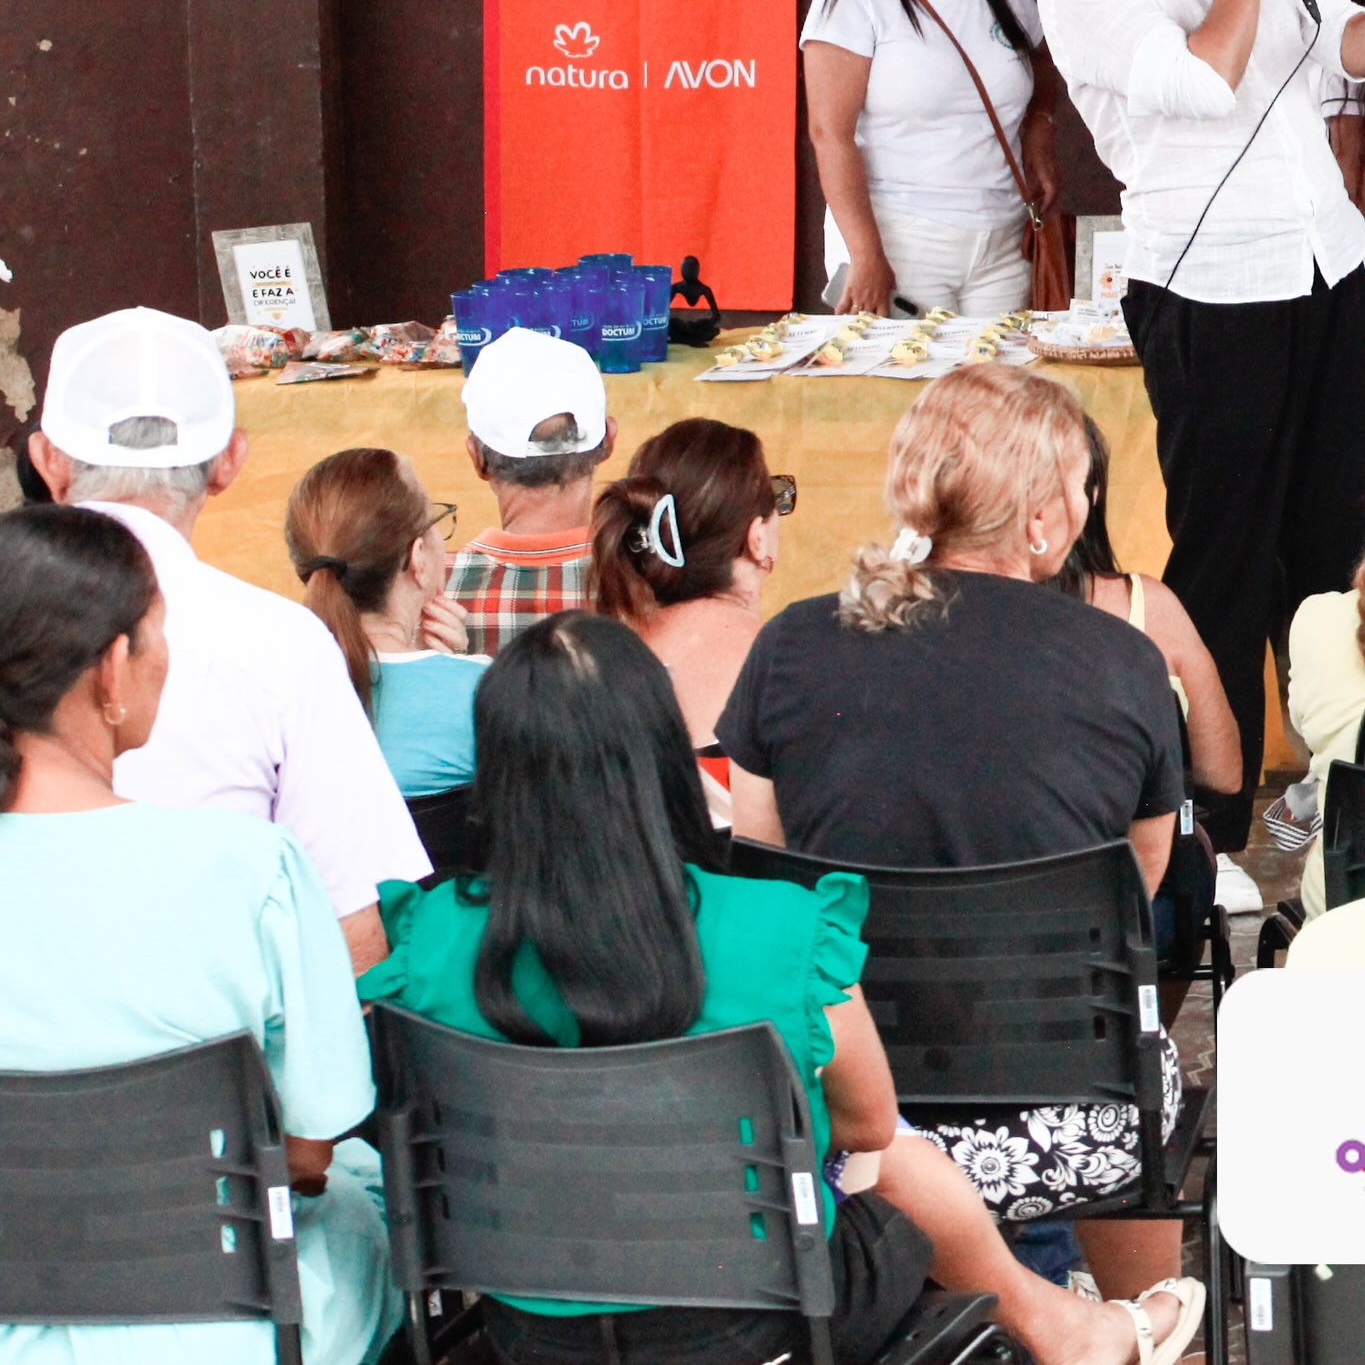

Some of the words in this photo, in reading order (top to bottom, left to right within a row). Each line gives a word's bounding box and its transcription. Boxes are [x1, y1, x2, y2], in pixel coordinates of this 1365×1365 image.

[526, 64, 629, 89] natura
[664, 59, 756, 88] AVON
[261, 287, 282, 297] FAZ
[602, 327, 635, 336] DOCTUM
